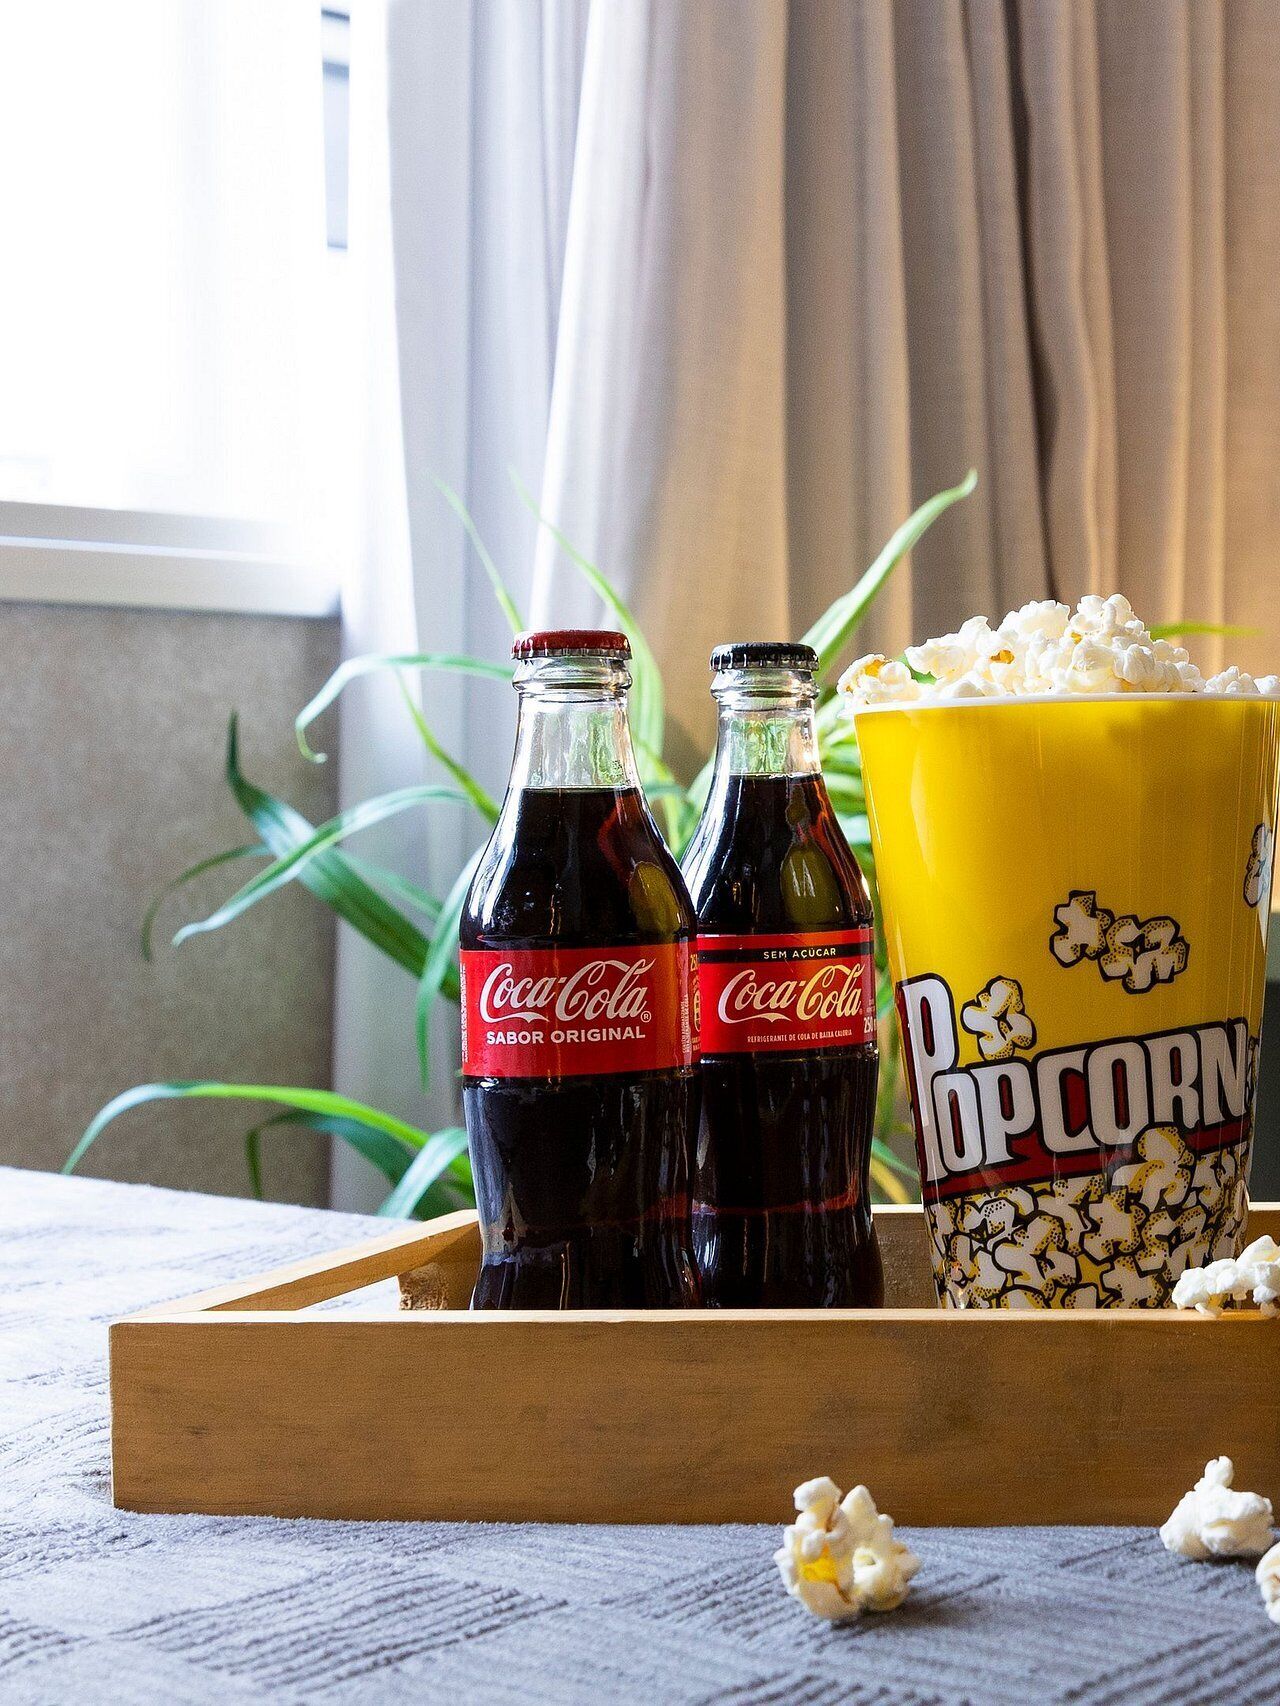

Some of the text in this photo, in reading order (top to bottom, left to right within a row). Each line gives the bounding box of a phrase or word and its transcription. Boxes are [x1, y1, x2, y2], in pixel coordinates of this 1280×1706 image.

[763, 948, 837, 960] SEM AÇÚCAR
[479, 958, 657, 1024] Coca-Cola
[717, 963, 866, 1024] Coca-Cola
[486, 1025, 646, 1045] SABOR ORIGINAL
[747, 1034, 788, 1043] REFRIGERANTE
[797, 1033, 811, 1041] COLA
[811, 1031, 819, 1040] DE
